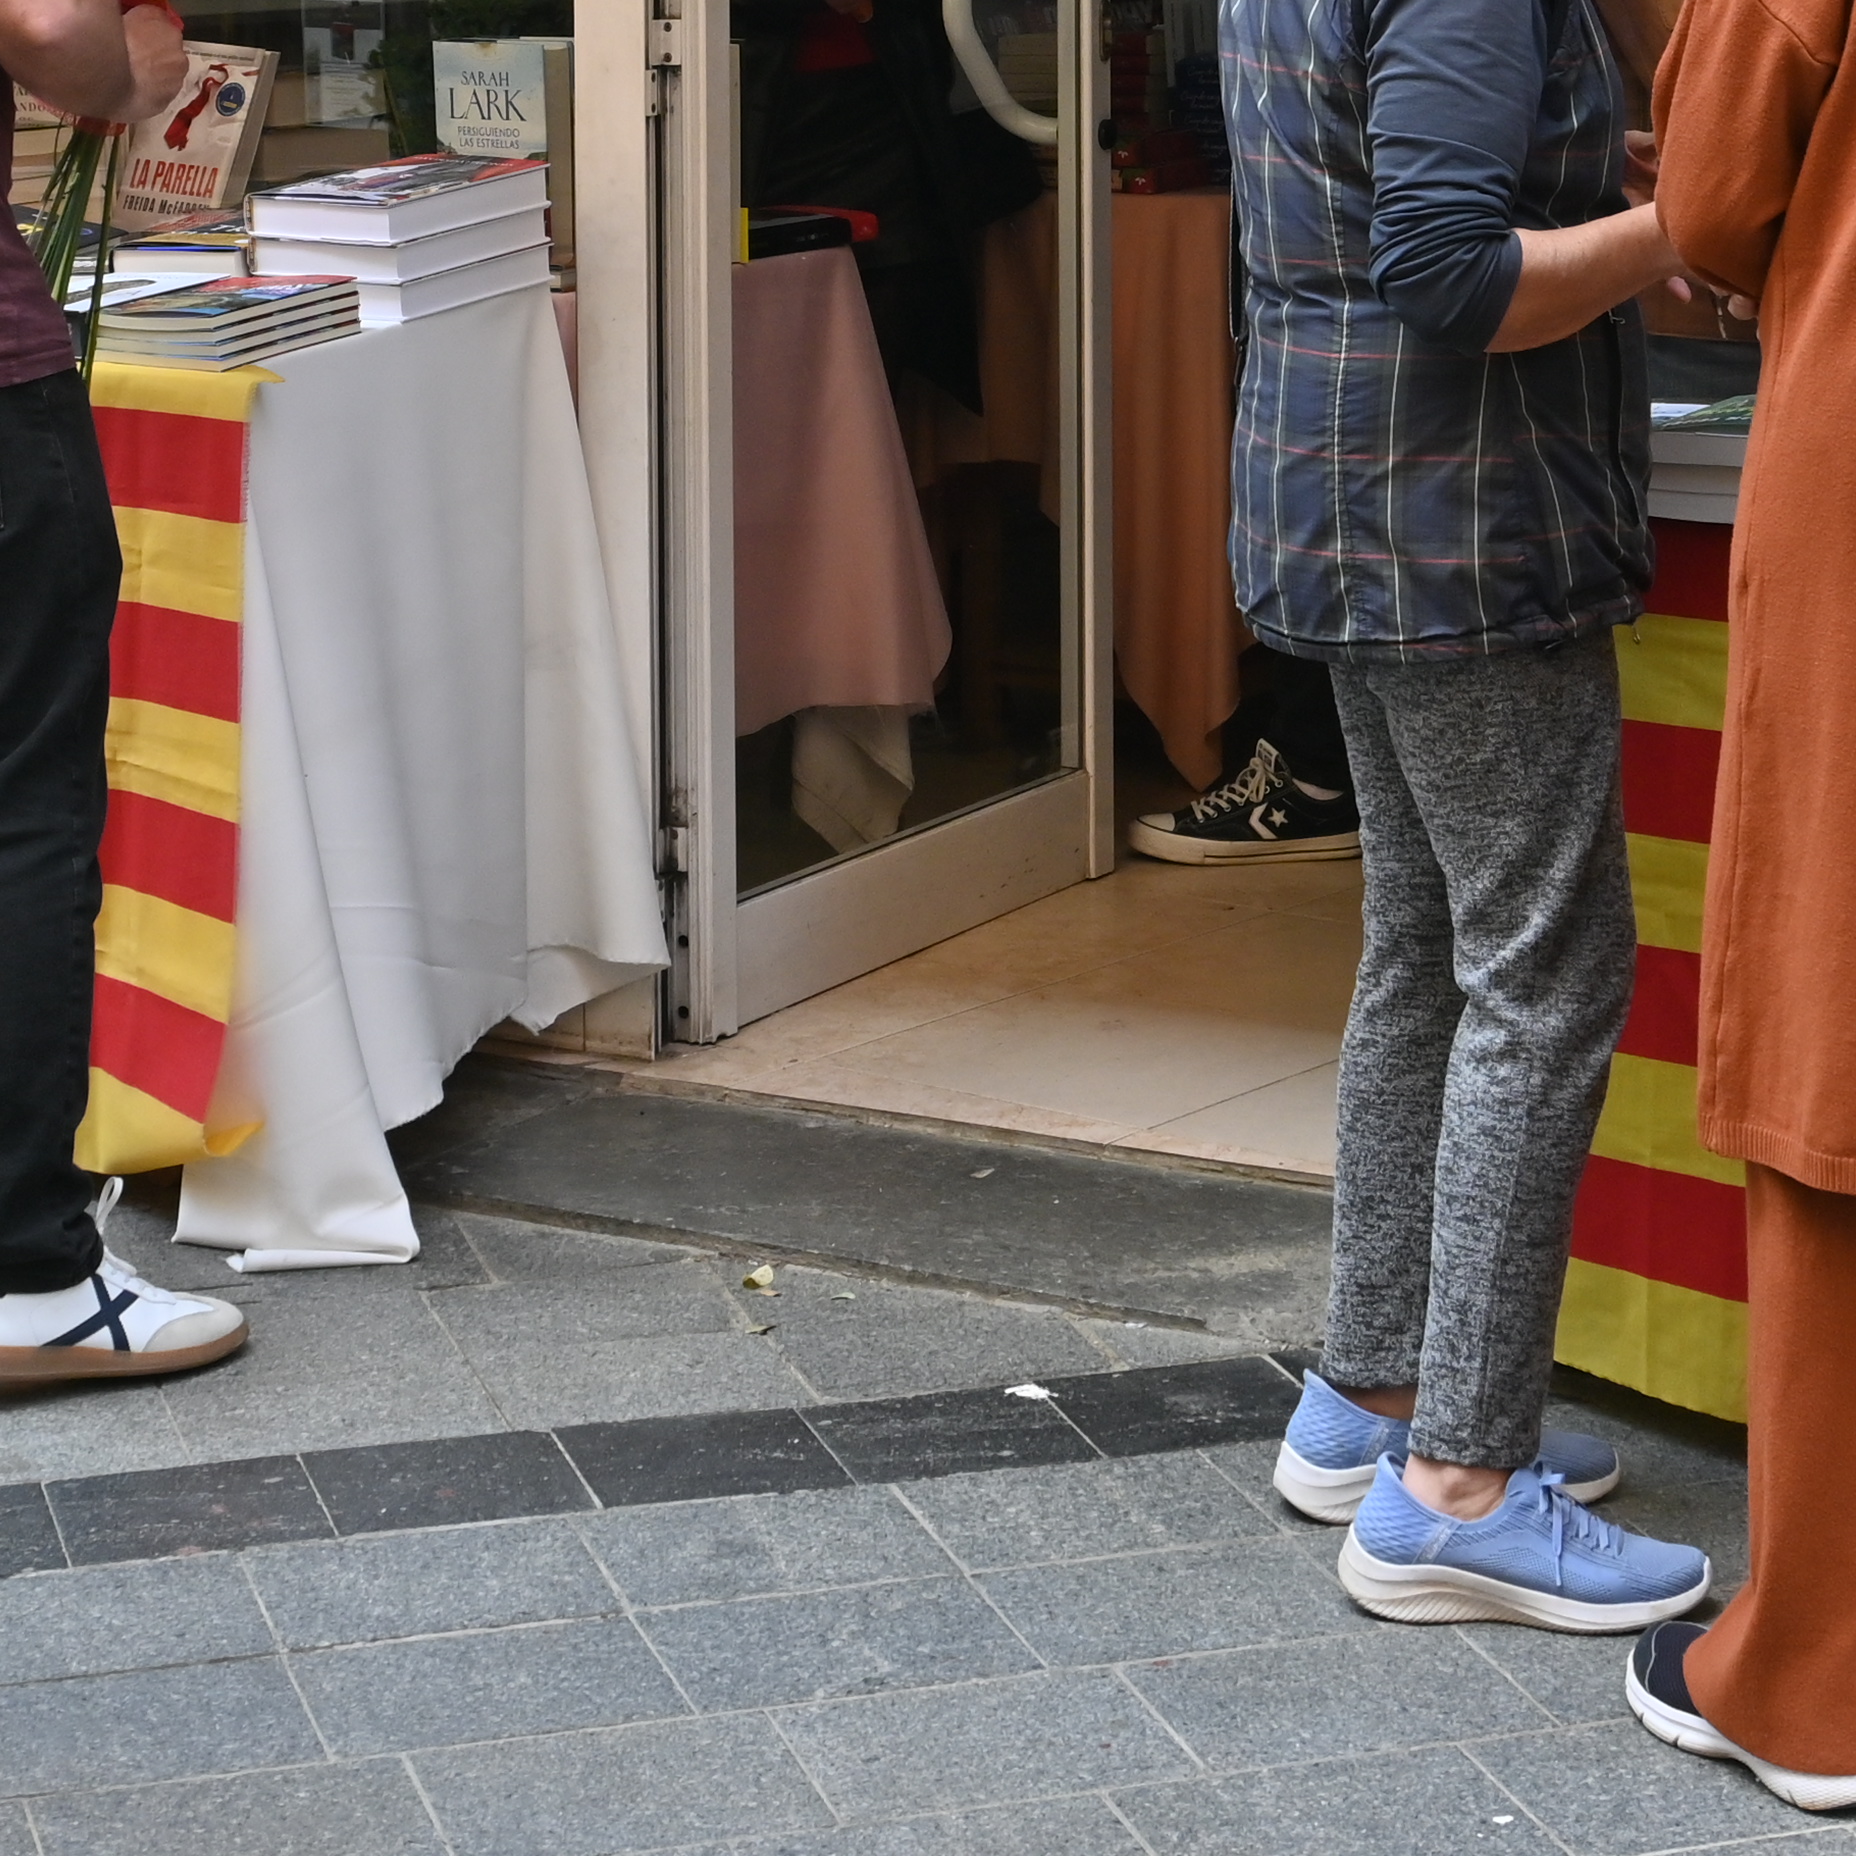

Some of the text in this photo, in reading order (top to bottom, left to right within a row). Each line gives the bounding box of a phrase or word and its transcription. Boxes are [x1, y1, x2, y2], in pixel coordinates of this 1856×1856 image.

[460, 70, 510, 87] SARAH
[449, 87, 527, 122] LARK
[457, 125, 520, 138] PERSIGUIENDO
[459, 138, 520, 150] LAS ESTRELLAS
[129, 157, 219, 199] LA PARELLA
[122, 194, 156, 213] FREIDA
